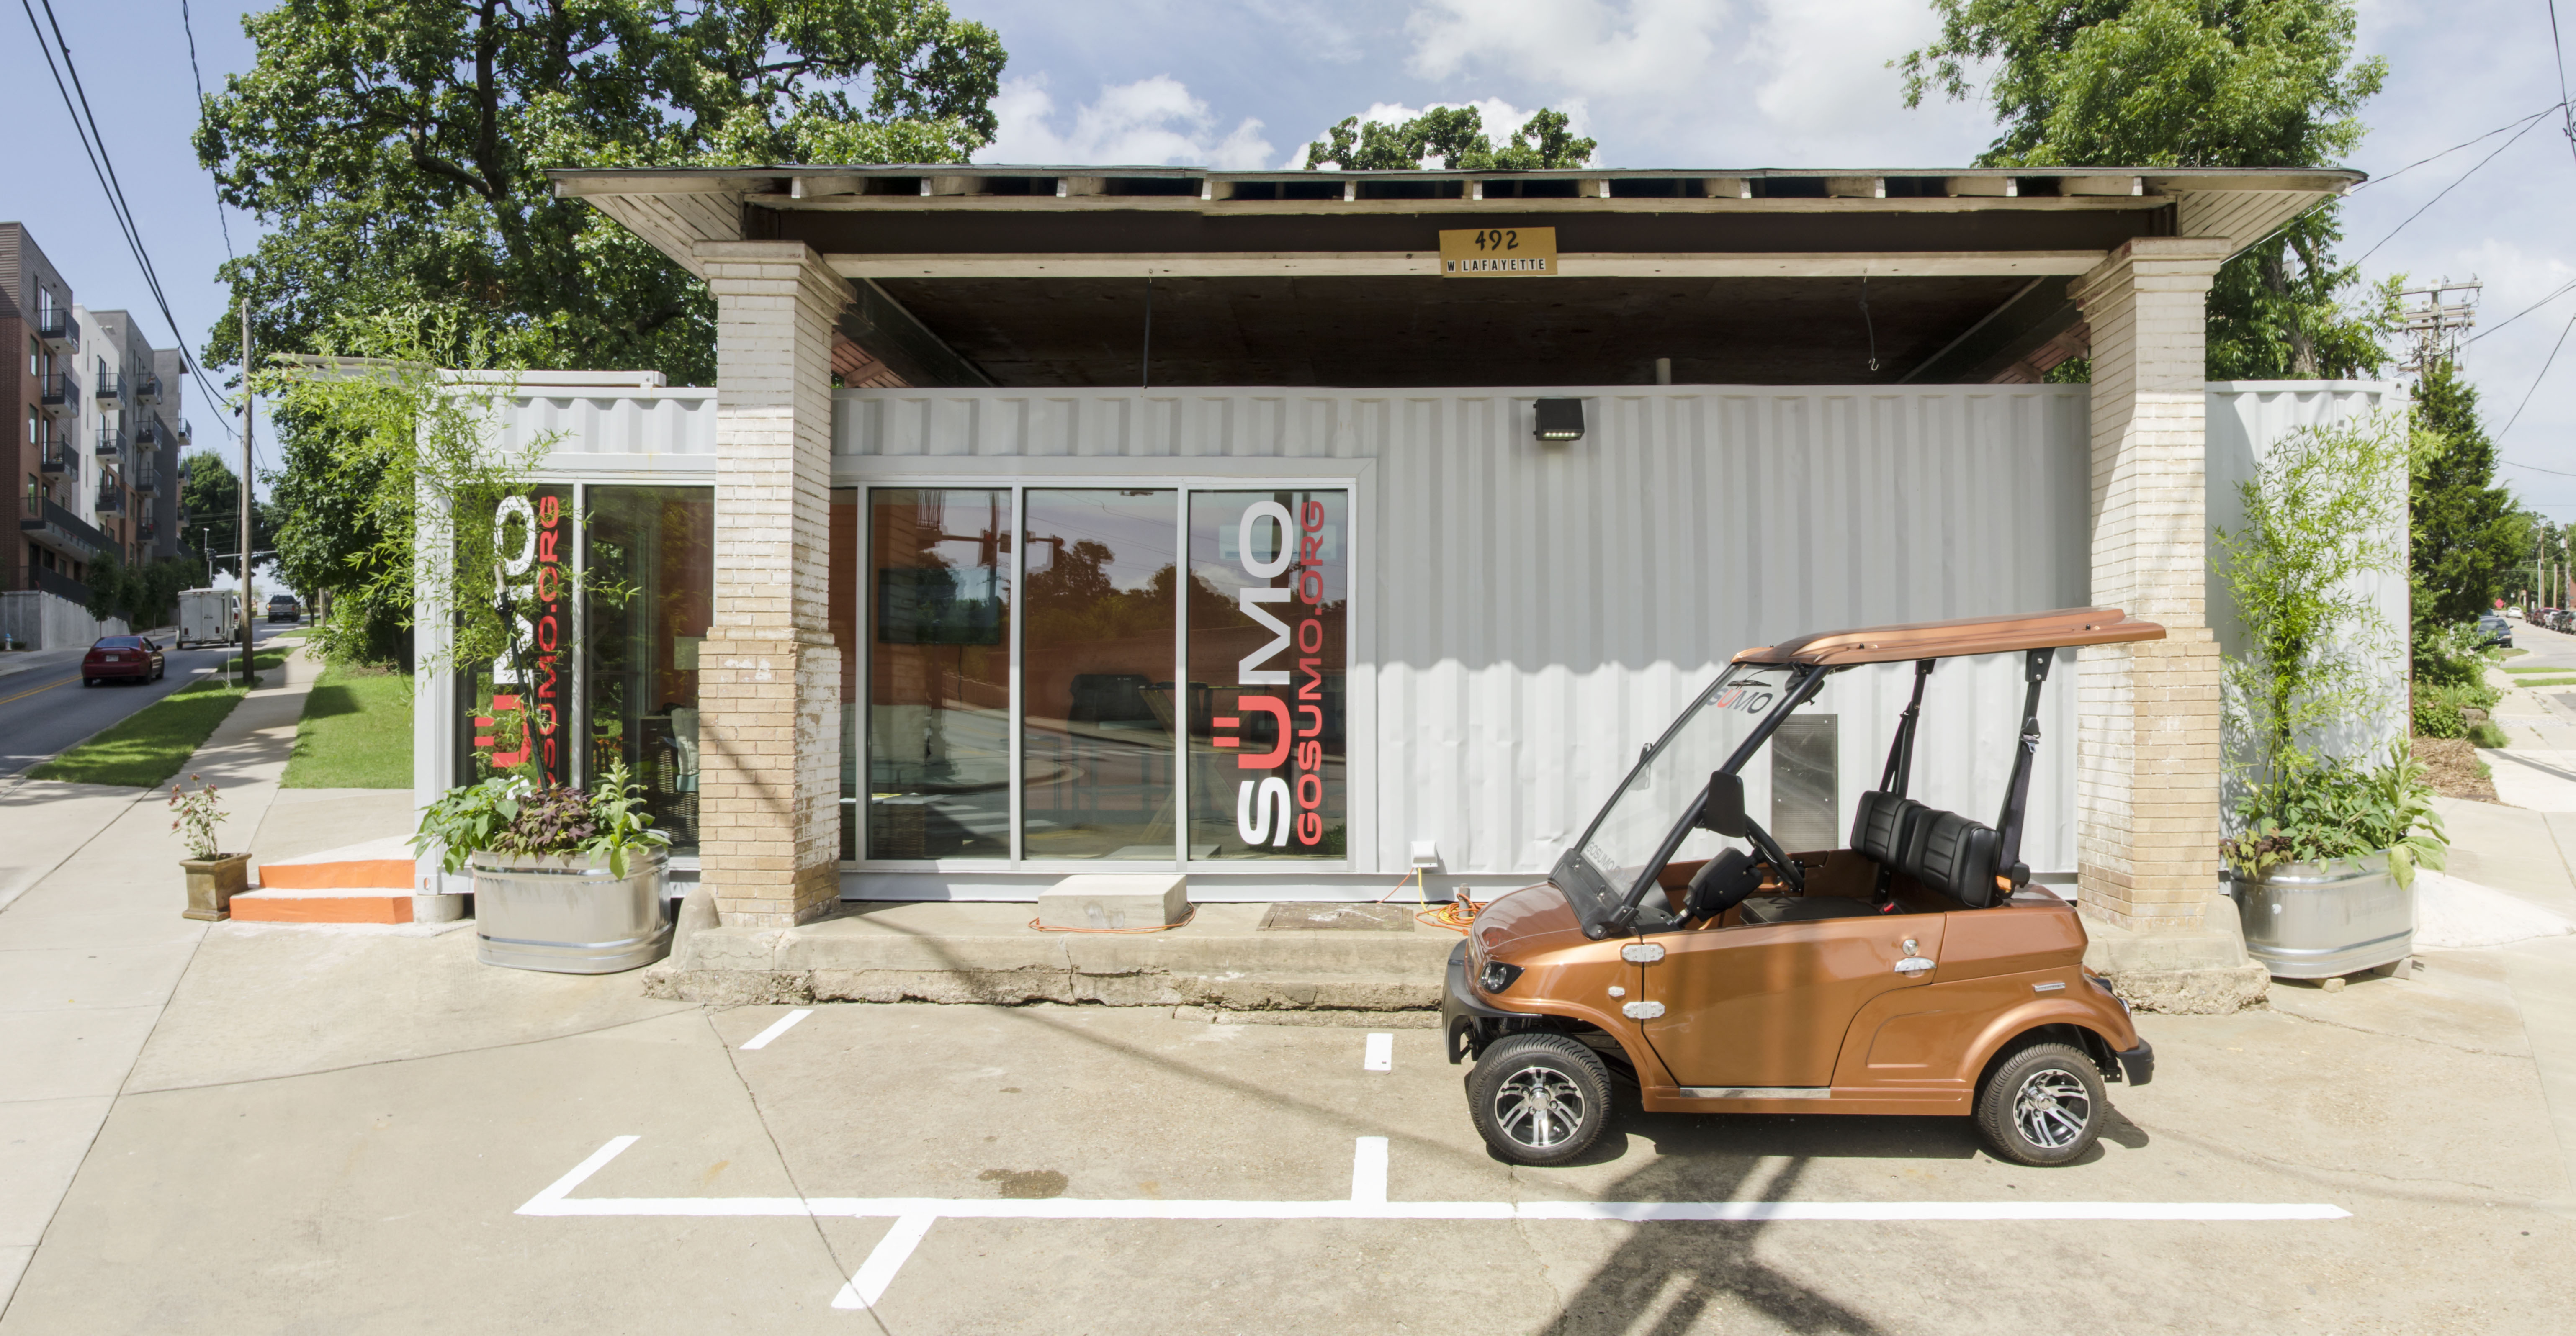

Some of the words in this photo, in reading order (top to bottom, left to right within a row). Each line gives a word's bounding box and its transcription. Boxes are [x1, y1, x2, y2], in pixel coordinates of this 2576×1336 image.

[1447, 261, 1455, 271] W
[1463, 259, 1544, 271] LAFAYETTE
[1475, 230, 1518, 251] 492
[474, 495, 536, 800] ÜMO
[537, 496, 559, 792] SUMO.ORG
[1212, 501, 1294, 846] SÜMO
[1297, 501, 1325, 845] GOSUMO.ORG
